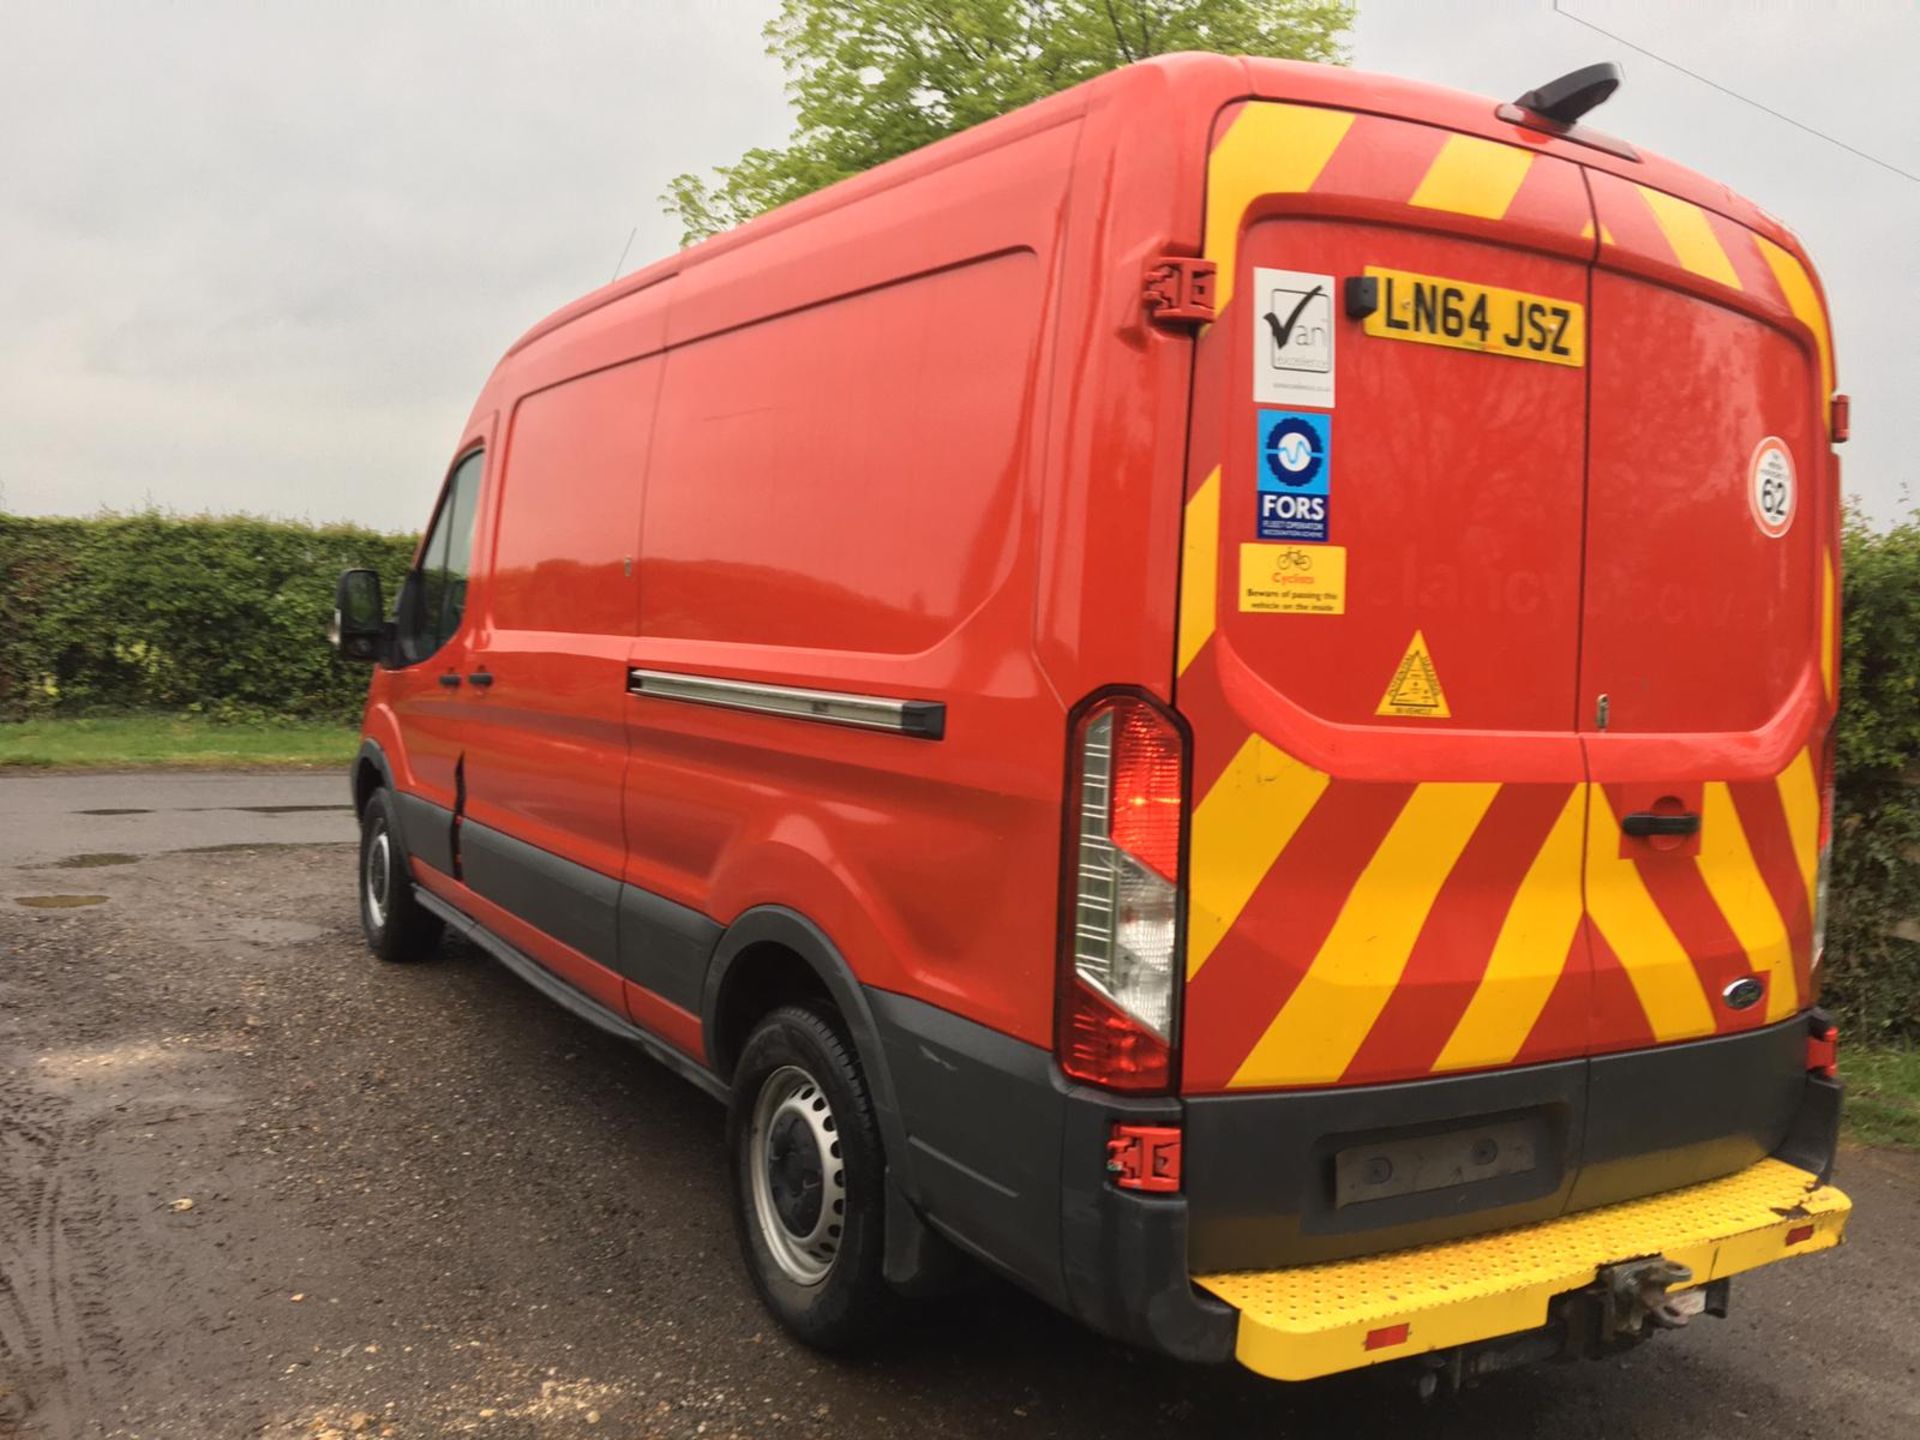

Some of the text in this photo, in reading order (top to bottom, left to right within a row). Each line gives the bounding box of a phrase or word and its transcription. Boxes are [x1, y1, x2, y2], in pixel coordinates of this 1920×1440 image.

[1385, 276, 1570, 356] LN64 JSZ
[1262, 495, 1325, 521] FORS
[1761, 478, 1787, 516] 62
[1247, 588, 1279, 598] Beware
[1281, 590, 1291, 598] of
[1291, 592, 1322, 602] passing
[1250, 602, 1280, 610] vehicle
[1295, 603, 1309, 611] the
